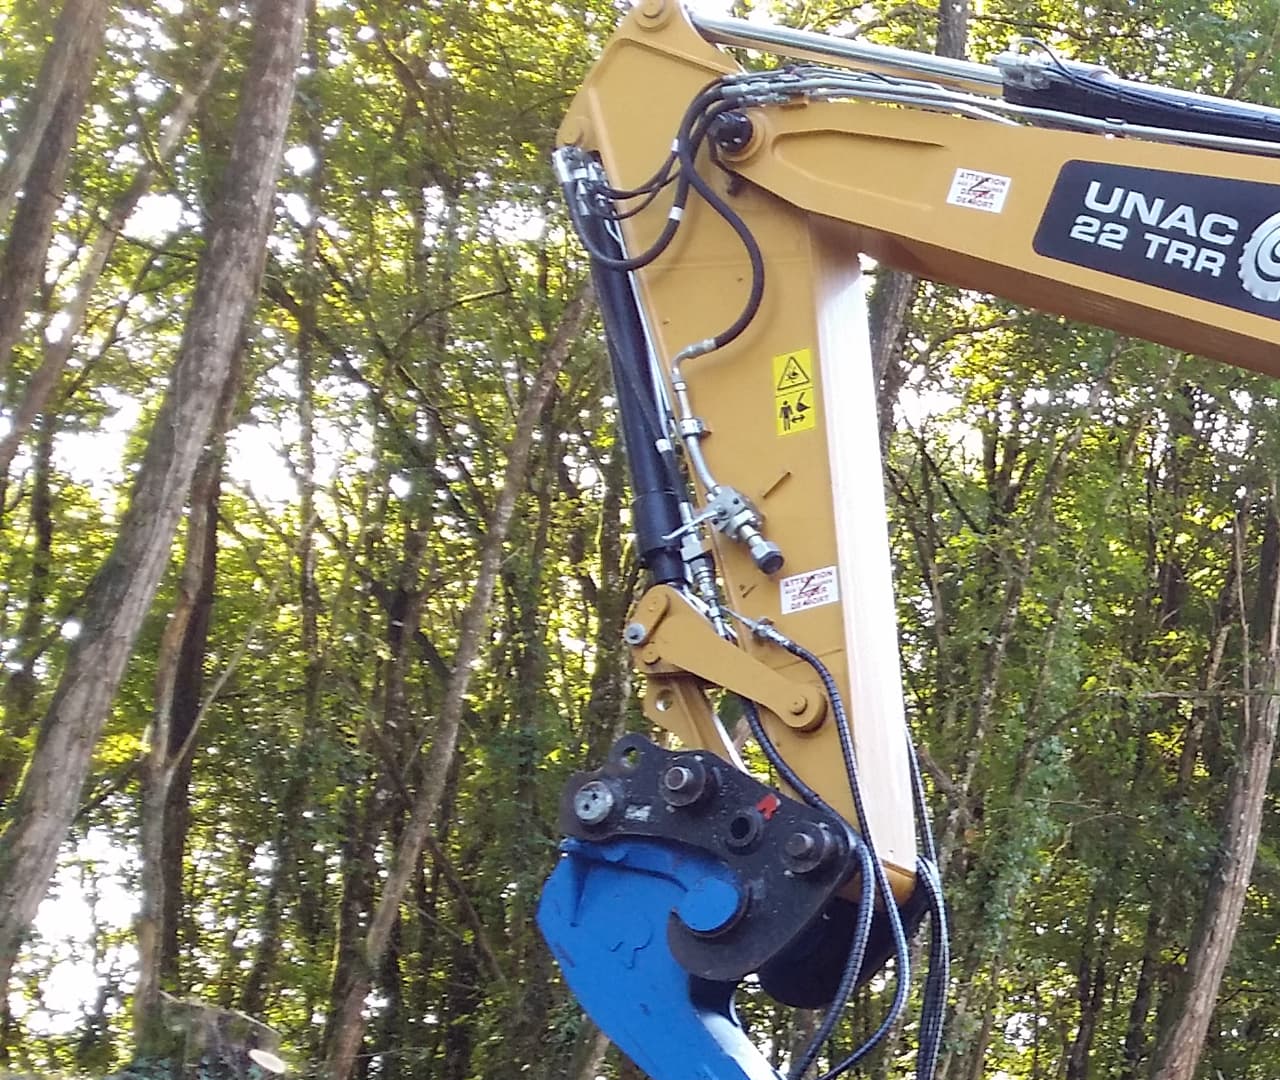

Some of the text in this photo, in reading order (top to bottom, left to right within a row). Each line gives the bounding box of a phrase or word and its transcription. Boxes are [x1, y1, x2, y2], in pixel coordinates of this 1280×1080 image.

[1084, 180, 1240, 246] UNAC
[1069, 214, 1227, 278] 22 TRR
